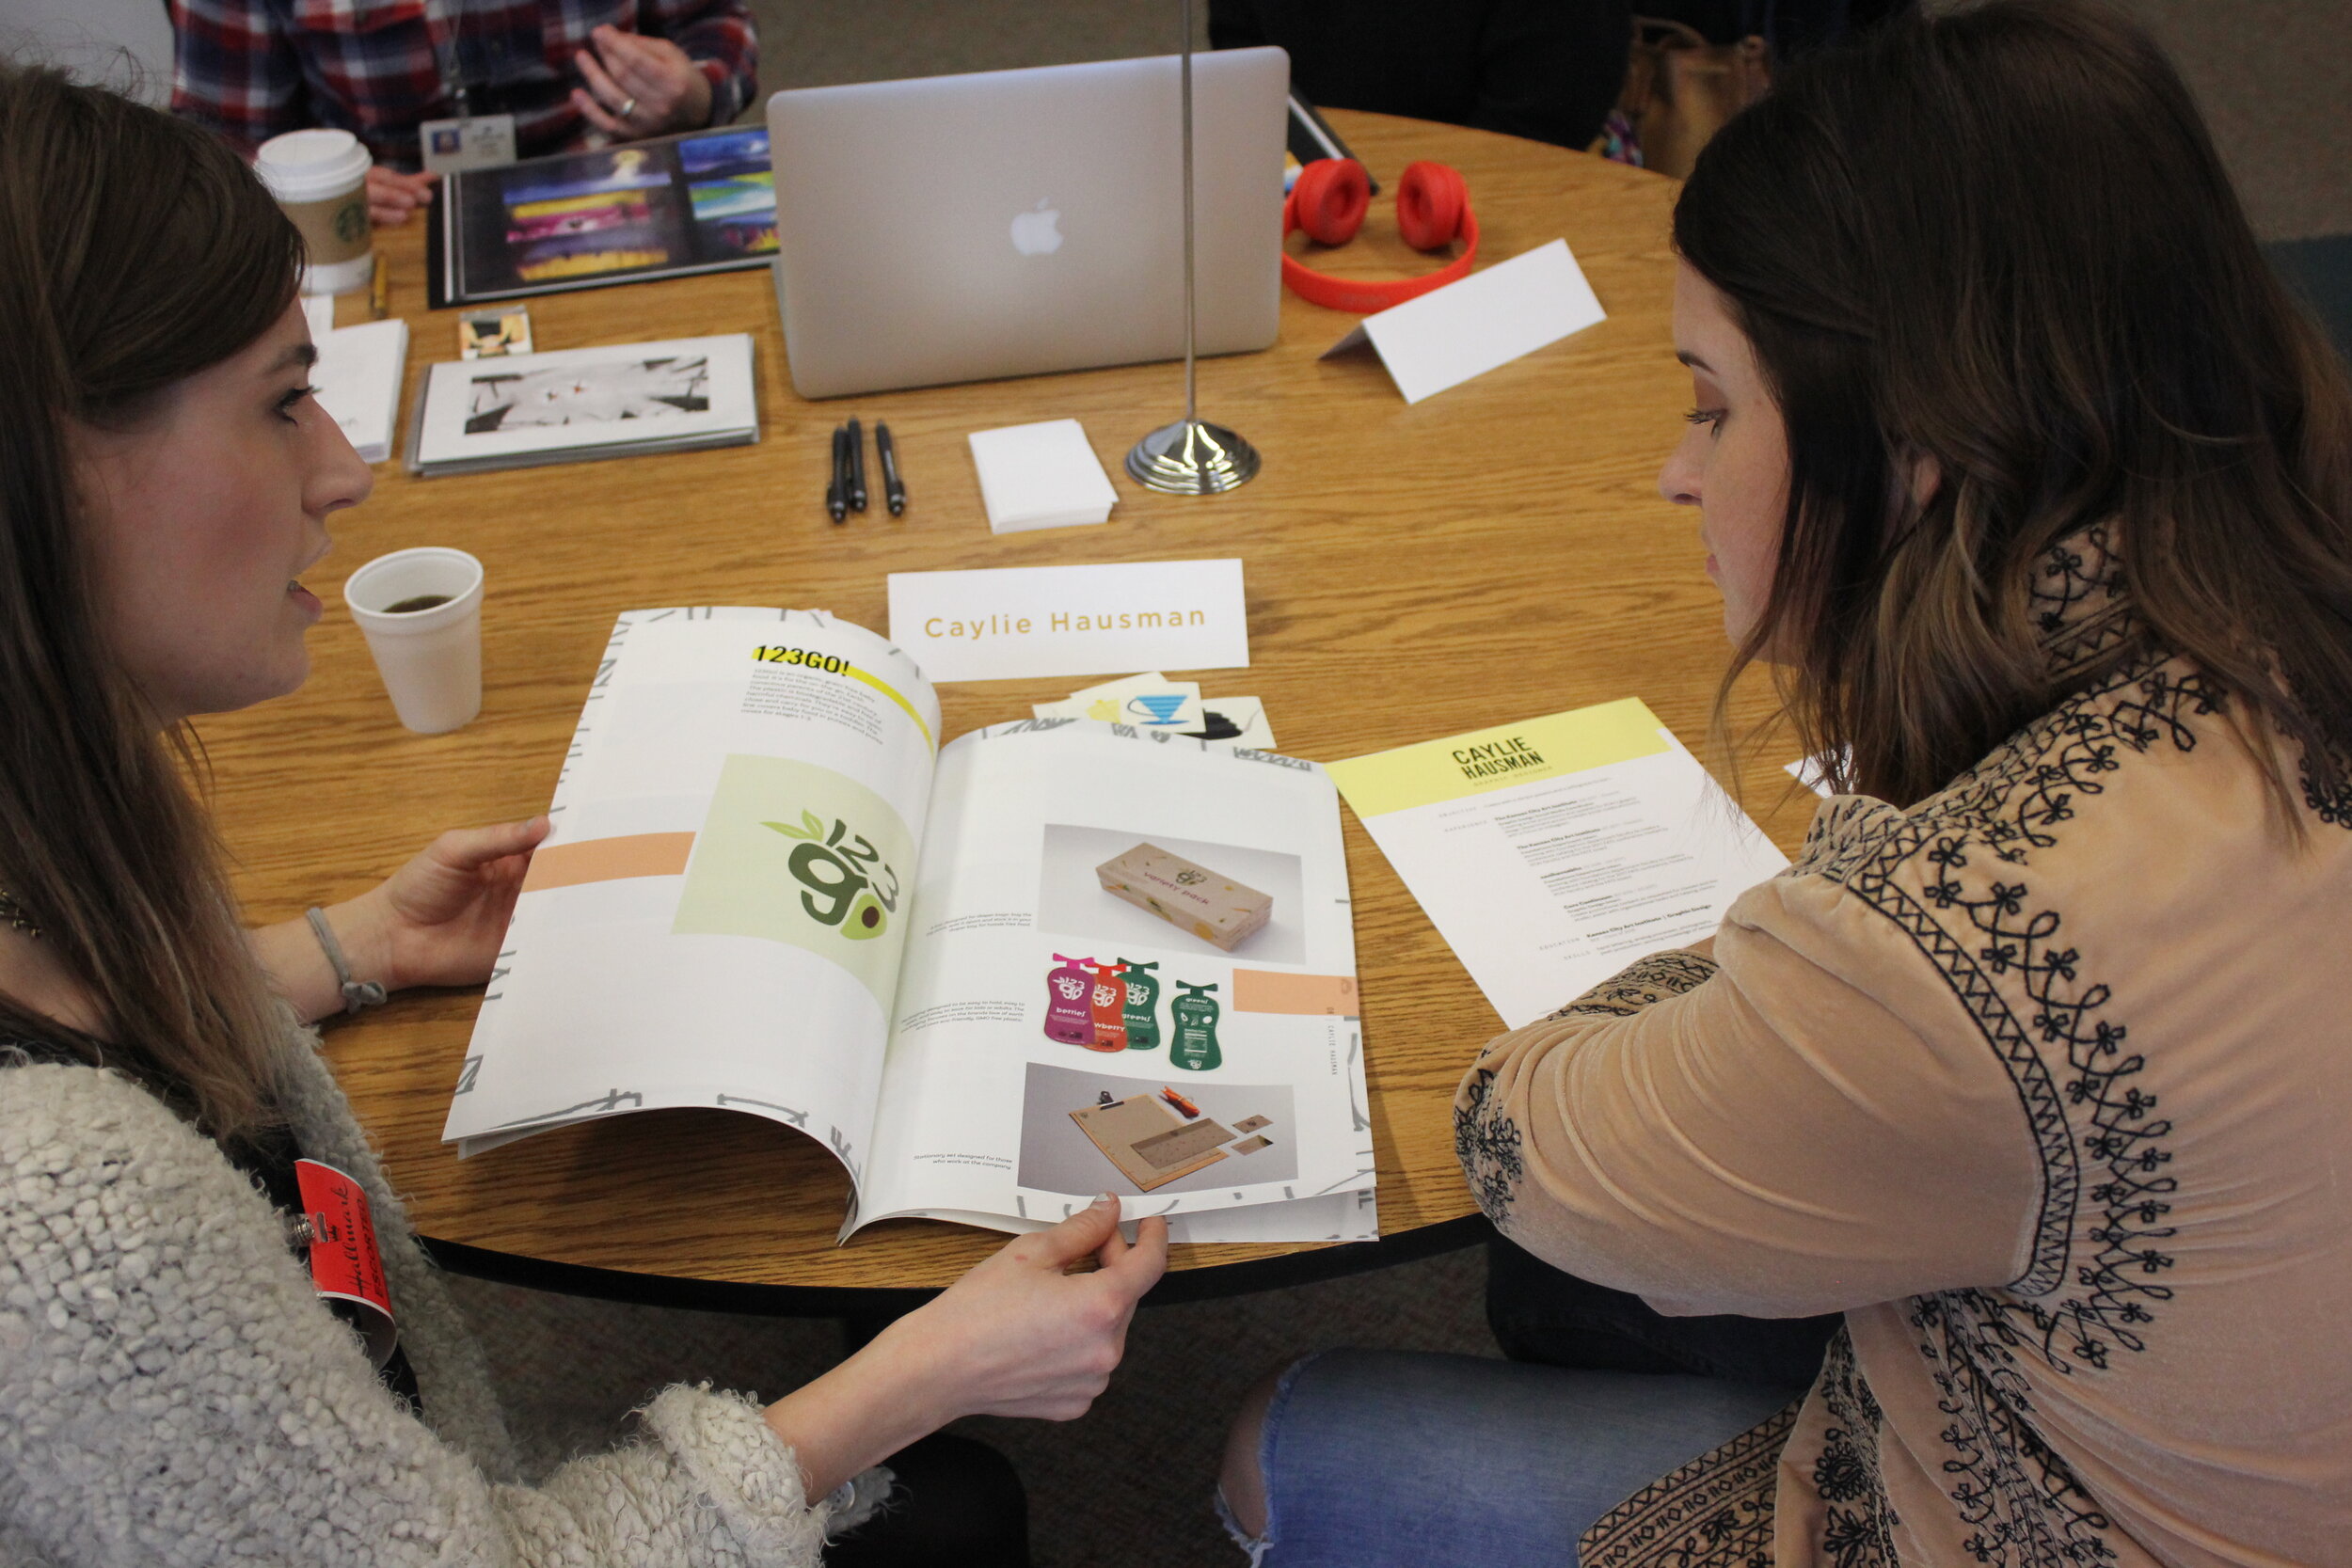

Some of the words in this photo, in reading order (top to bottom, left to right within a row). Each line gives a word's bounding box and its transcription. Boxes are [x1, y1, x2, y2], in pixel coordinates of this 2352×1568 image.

[924, 613, 1032, 640] Caylie
[1050, 610, 1205, 631] Hausman
[757, 645, 850, 677] 123GO!
[1452, 736, 1532, 765] CAYLIE
[1461, 751, 1544, 780] HAUSMAN
[1144, 872, 1181, 892] variety
[1182, 890, 1210, 905] pack
[1056, 1006, 1087, 1018] berries
[982, 1162, 1011, 1170] company
[330, 1181, 372, 1297] Hallmark
[357, 1198, 385, 1298] ESCORTED
